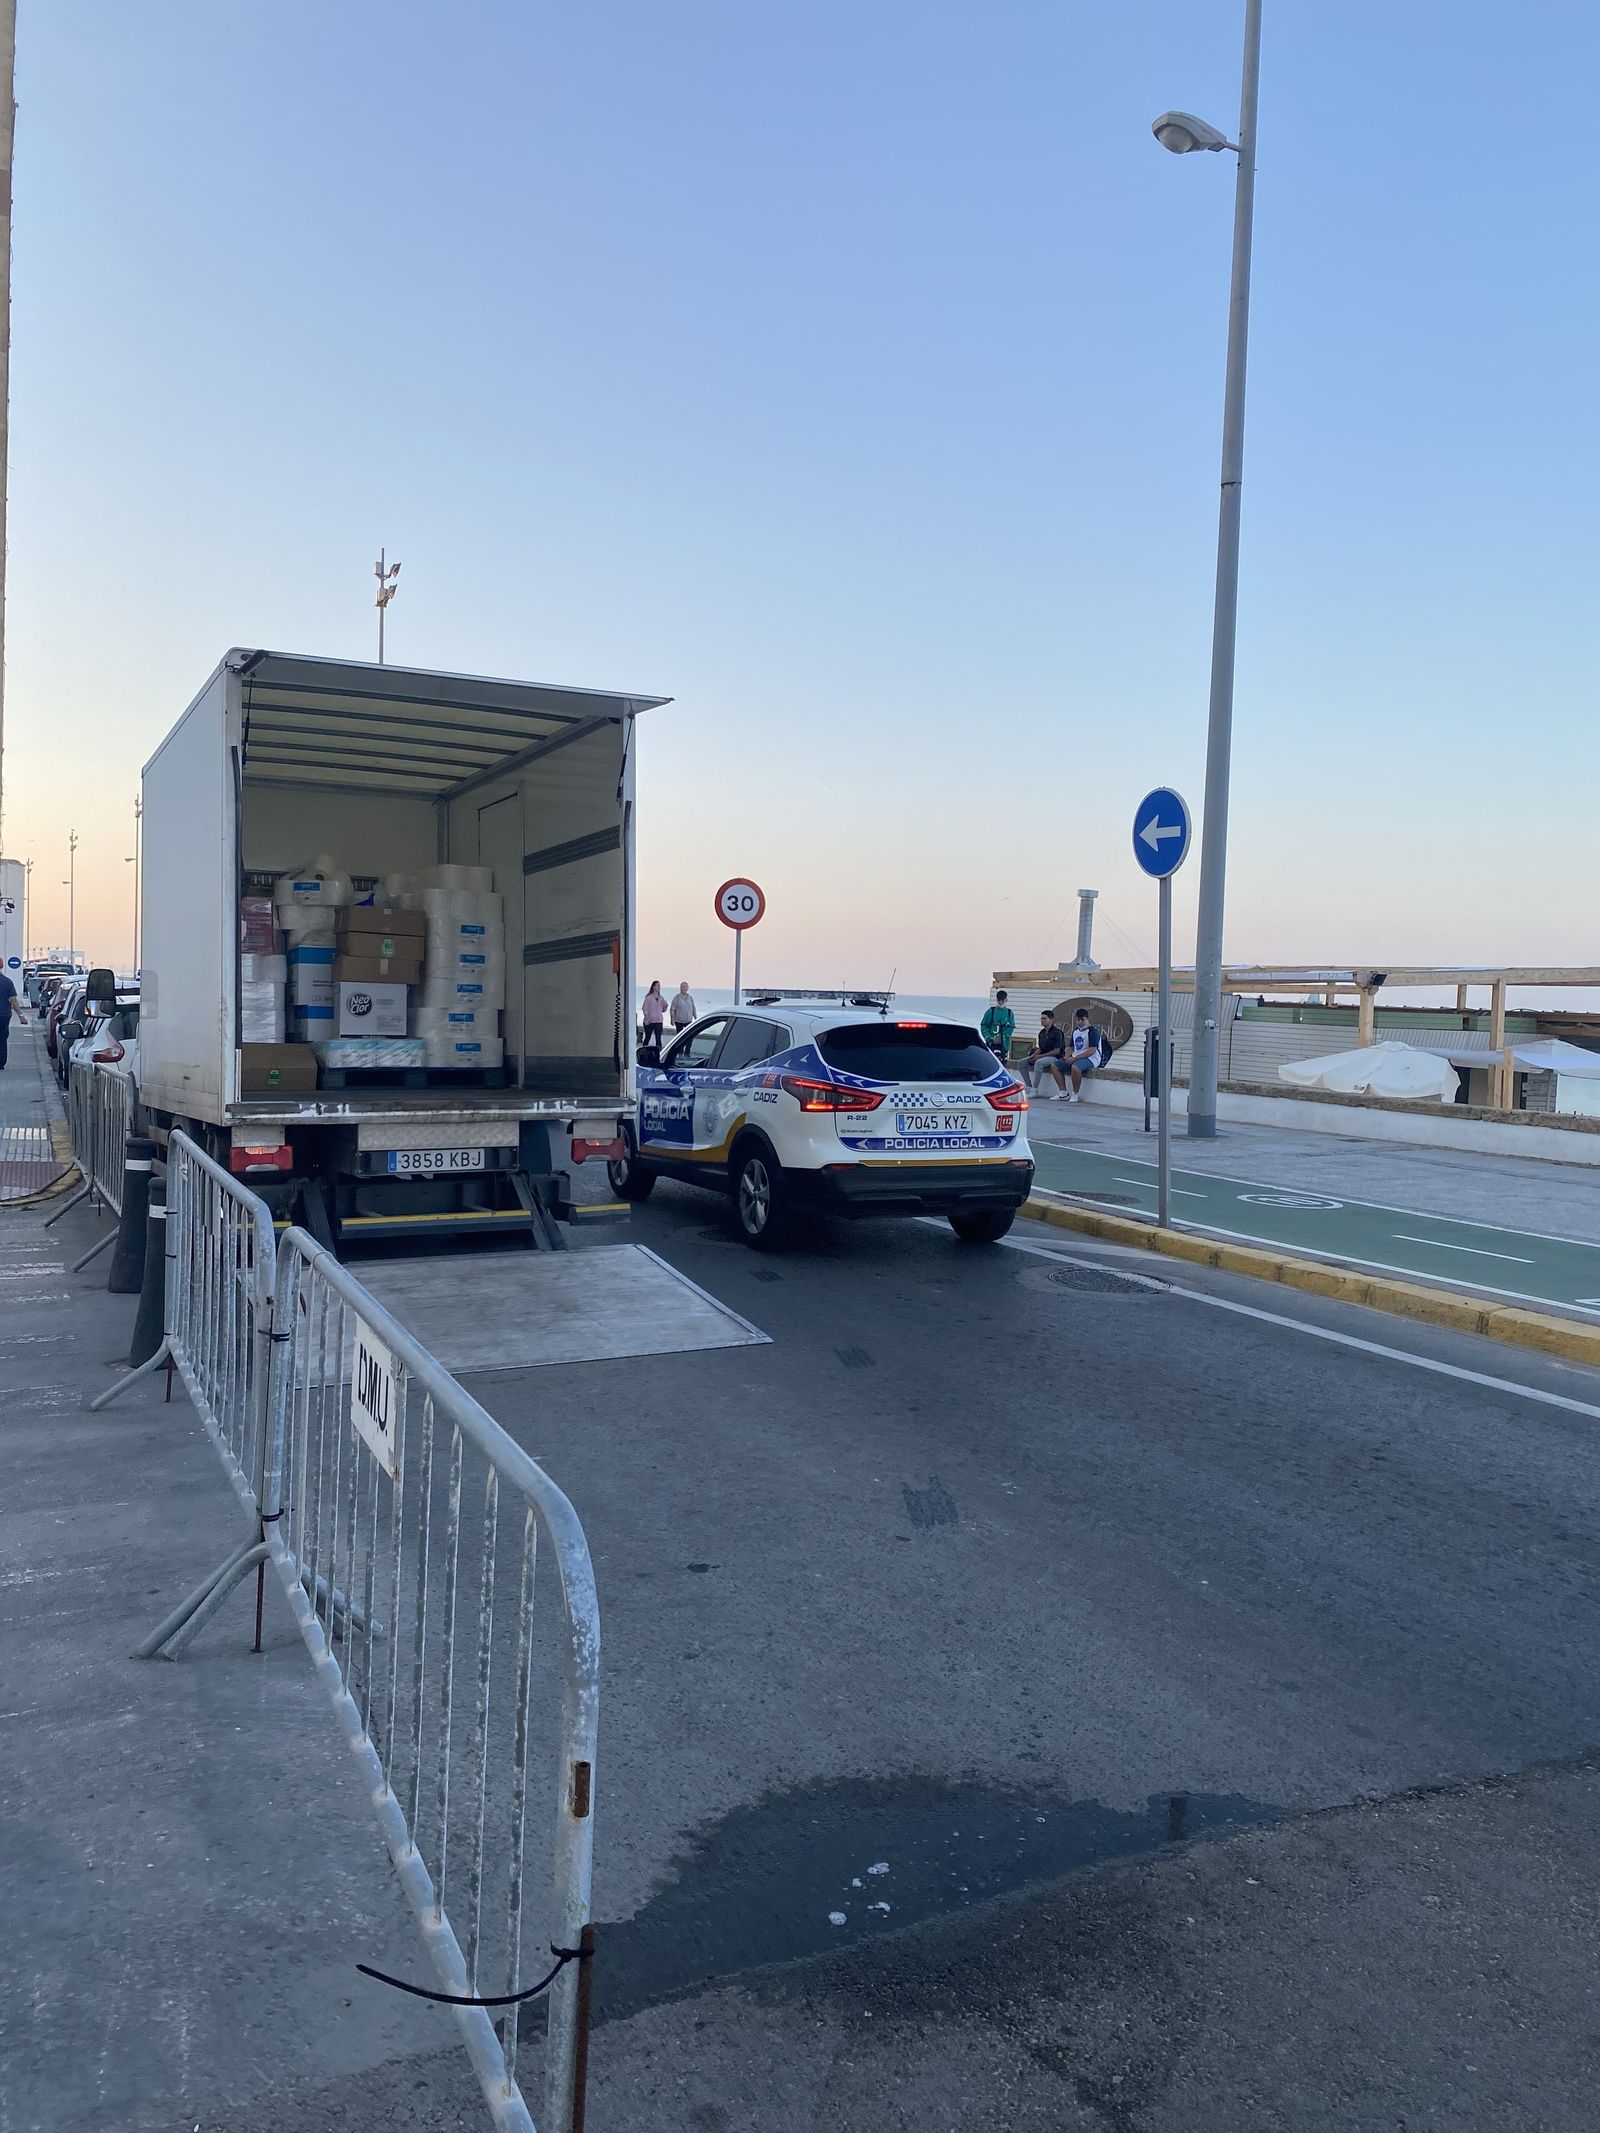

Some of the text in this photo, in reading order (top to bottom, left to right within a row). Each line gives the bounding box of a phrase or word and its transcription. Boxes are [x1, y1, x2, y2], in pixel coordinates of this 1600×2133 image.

[727, 895, 754, 911] 30
[350, 996, 370, 1006] Neo
[350, 1004, 370, 1014] Clor
[753, 1092, 779, 1104] CADIZ
[946, 1095, 982, 1104] CADIZ
[643, 1099, 689, 1120] POLICIA
[643, 1120, 667, 1132] LOCAL
[906, 1115, 968, 1130] 7045 KYZ
[884, 1138, 985, 1149] POLICIA LOCAL
[401, 1151, 481, 1169] 3858 KBJ
